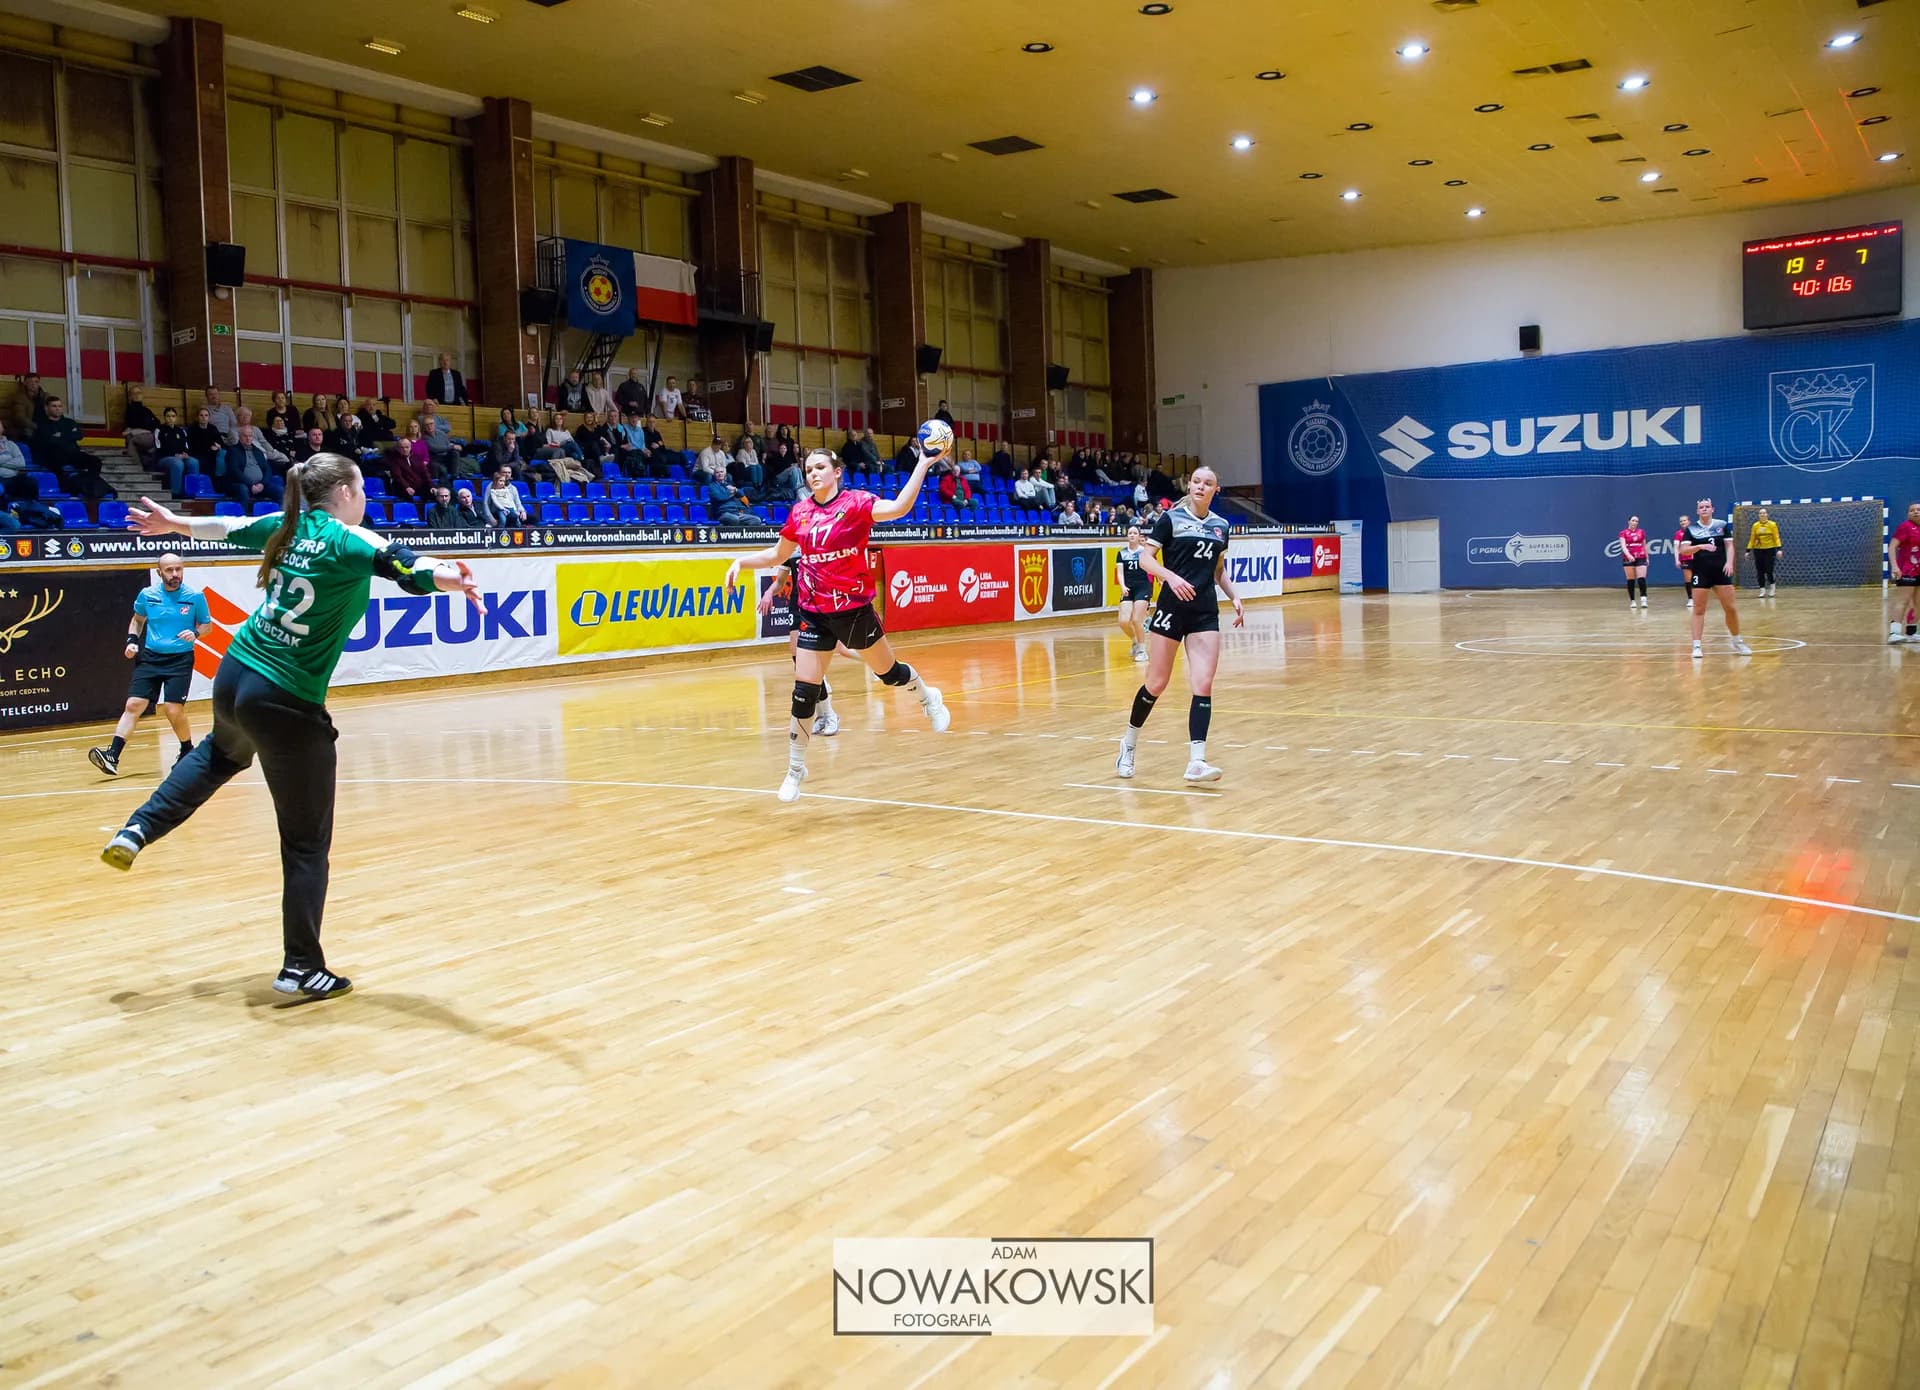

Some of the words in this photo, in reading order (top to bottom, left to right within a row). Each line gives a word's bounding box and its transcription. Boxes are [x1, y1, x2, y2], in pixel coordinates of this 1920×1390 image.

[1786, 257, 1805, 274] 19
[1815, 259, 1825, 271] 2
[1856, 249, 1868, 265] 7
[1447, 405, 1701, 459] SUZUKI
[1780, 407, 1854, 460] CK
[388, 532, 496, 547] koronahandball.pl
[557, 529, 671, 544] www.koronahandball.pl
[720, 528, 780, 540] www.koronaha
[809, 523, 833, 547] 17
[869, 528, 929, 539] .koronahandball.pl
[1193, 540, 1214, 560] 24
[281, 553, 311, 570] ŁOCK
[1128, 561, 1138, 570] 21
[980, 572, 992, 580] LIGA
[1224, 556, 1277, 583] UZUKI
[914, 575, 928, 583] LIGA
[1693, 576, 1699, 585] 3
[914, 584, 948, 593] CENTRALNA
[1021, 575, 1043, 606] CK
[1064, 584, 1094, 596] PROFIKA
[610, 583, 746, 622] LEWIATAN
[343, 590, 547, 652] UZUKI
[1153, 610, 1173, 631] 24
[15, 666, 66, 681] ECHO
[1, 702, 69, 716] TELECHO.EU
